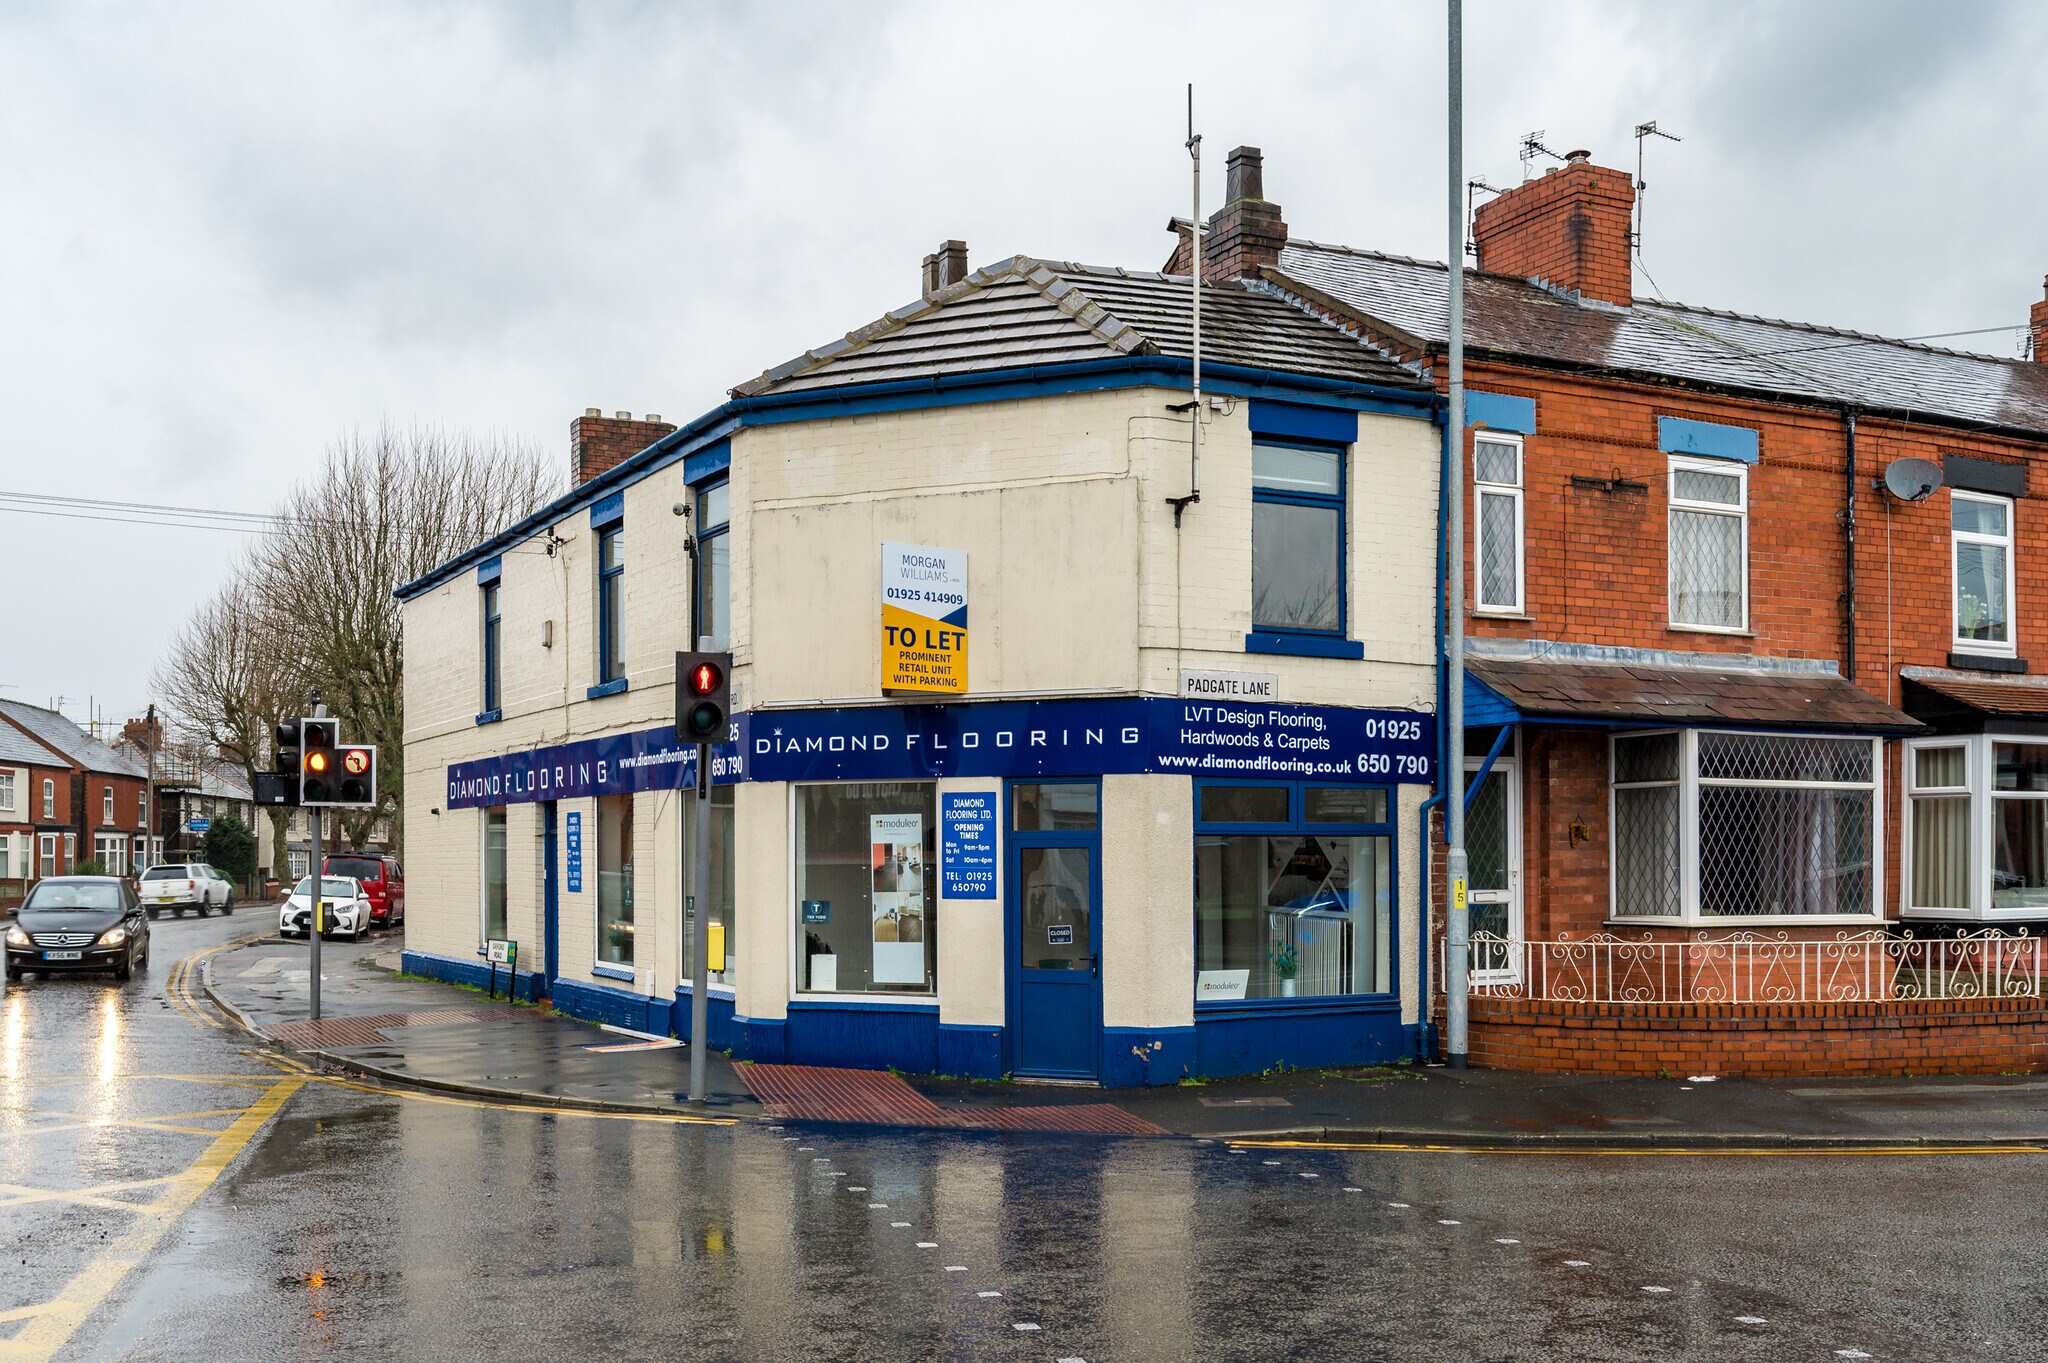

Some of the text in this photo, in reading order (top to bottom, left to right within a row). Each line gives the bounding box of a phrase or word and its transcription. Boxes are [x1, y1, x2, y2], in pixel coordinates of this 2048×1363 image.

[902, 555, 945, 569] MORGAN
[887, 587, 963, 605] 01925 414909
[884, 625, 966, 652] TO LET
[899, 651, 952, 664] PROMINENT
[898, 662, 952, 675] RETAIL UNIT
[893, 674, 958, 687] WITH PARKING
[1187, 678, 1271, 696] PADGATE LANE
[1184, 706, 1328, 731] LVT Design Flooring,
[1365, 718, 1421, 741] 01925
[756, 727, 1139, 754] DIAMOND FLOORING
[1180, 729, 1330, 752] Hardwoods & Carpets
[619, 746, 697, 769] www.diamondflooring.co
[712, 756, 743, 776] 650 790
[1158, 753, 1352, 775] www.diamondflooring.co.uk
[1357, 753, 1429, 775] 650 790
[450, 760, 607, 800] DIAMOND FLOORING
[953, 799, 985, 808] DIAMOND
[945, 810, 993, 819] FLOORING LTD.
[954, 823, 984, 831] OPENING
[959, 831, 979, 840] TIMES
[946, 872, 993, 880] TEL: 01925
[952, 883, 987, 892] 650790
